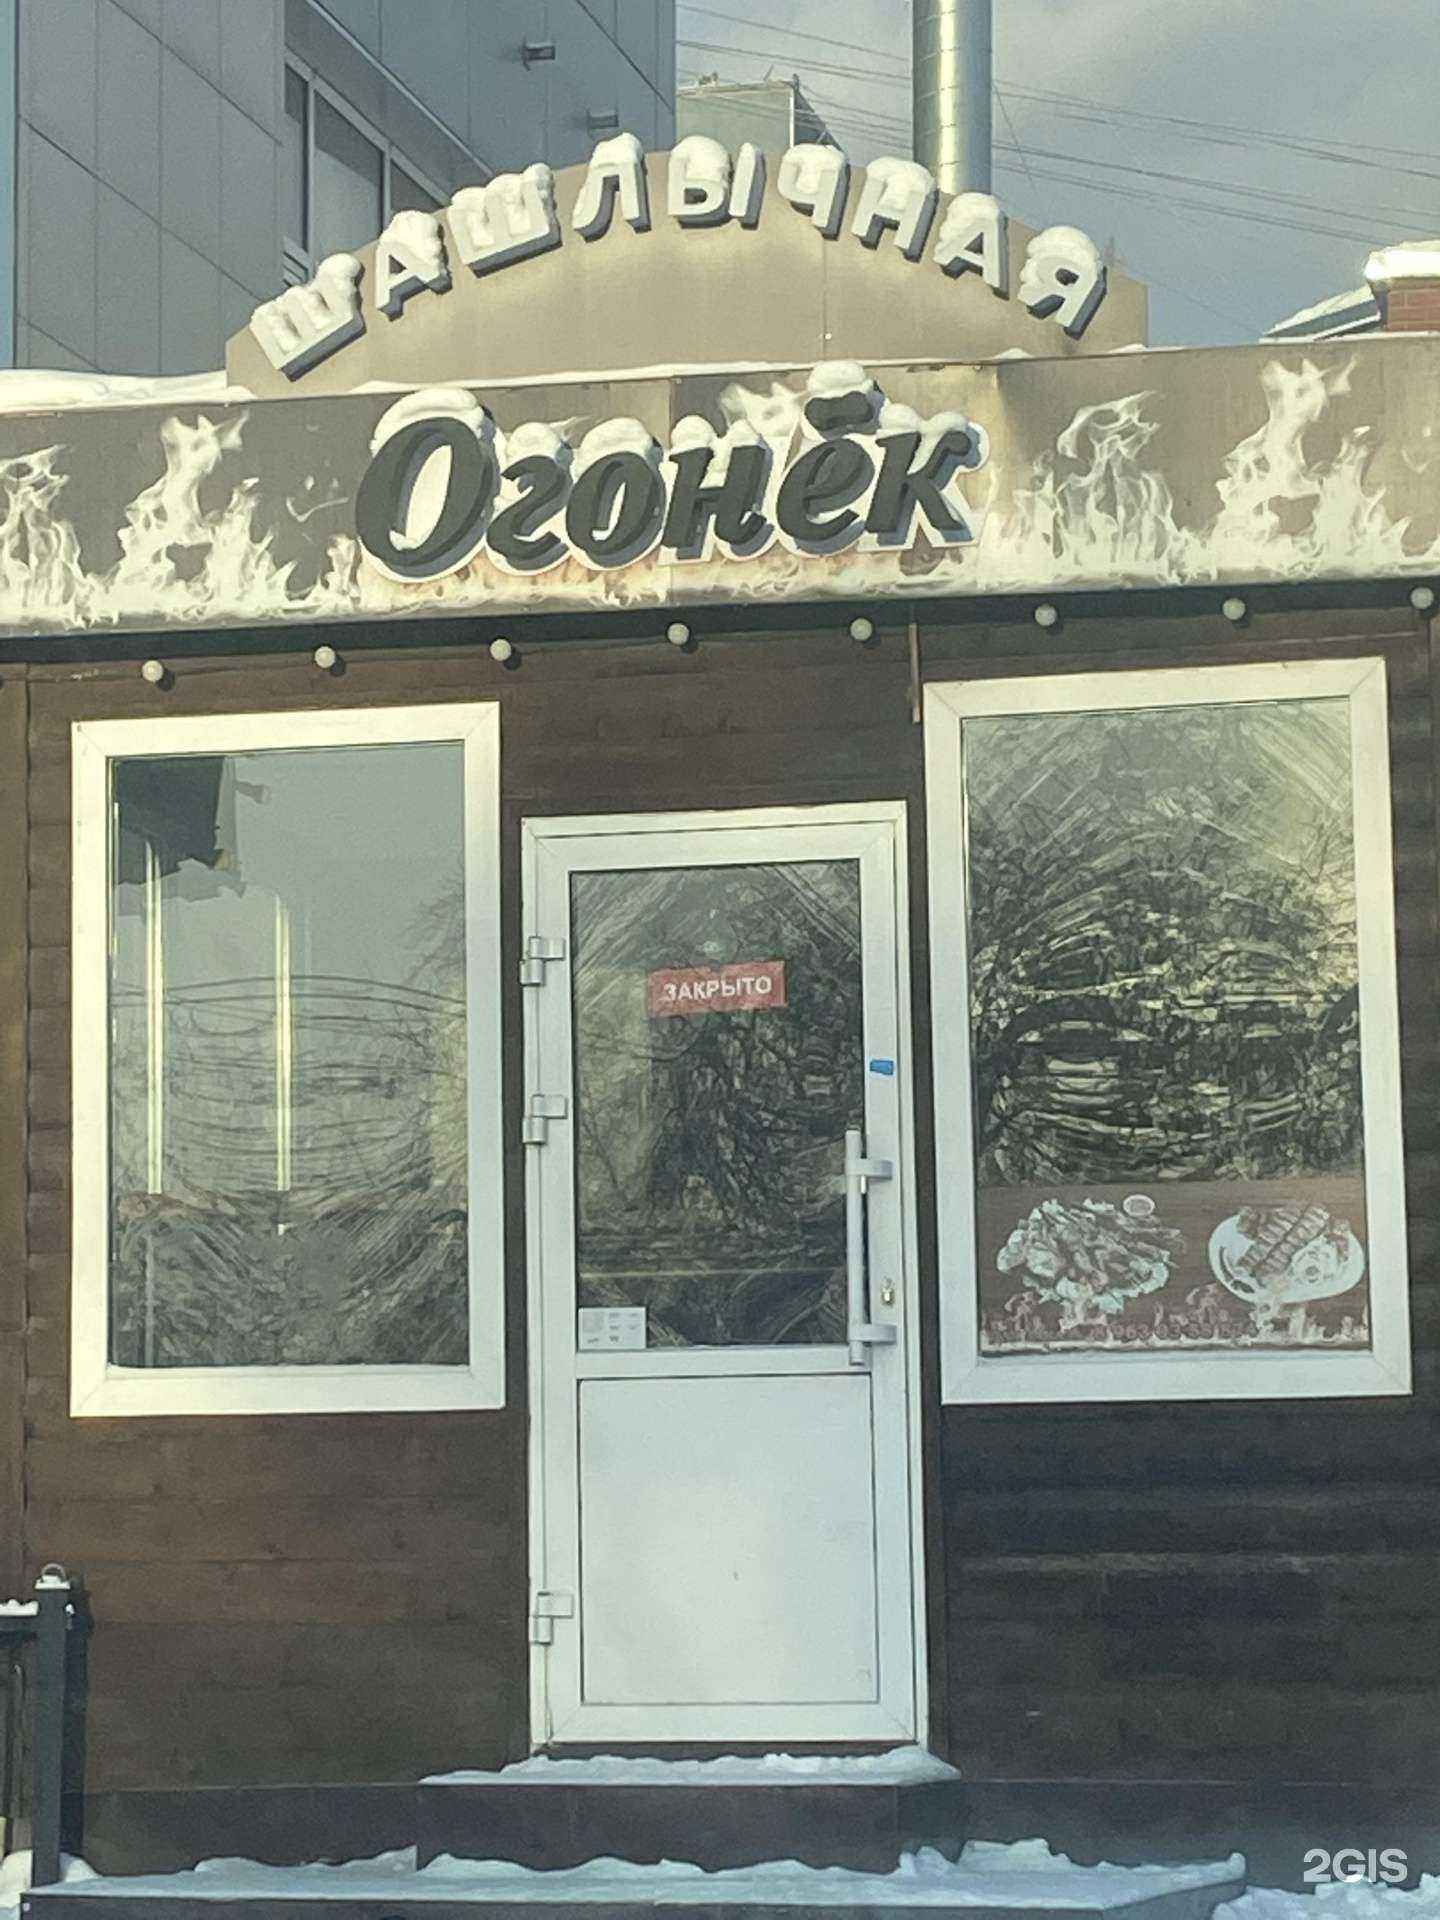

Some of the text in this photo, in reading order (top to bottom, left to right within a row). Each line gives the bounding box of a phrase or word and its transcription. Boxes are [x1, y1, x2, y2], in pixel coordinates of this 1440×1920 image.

[250, 132, 1107, 378] ШАШЛЫЧНАЯ
[356, 378, 990, 580] Огонёк
[662, 976, 773, 1001] ЗАКРЫТО
